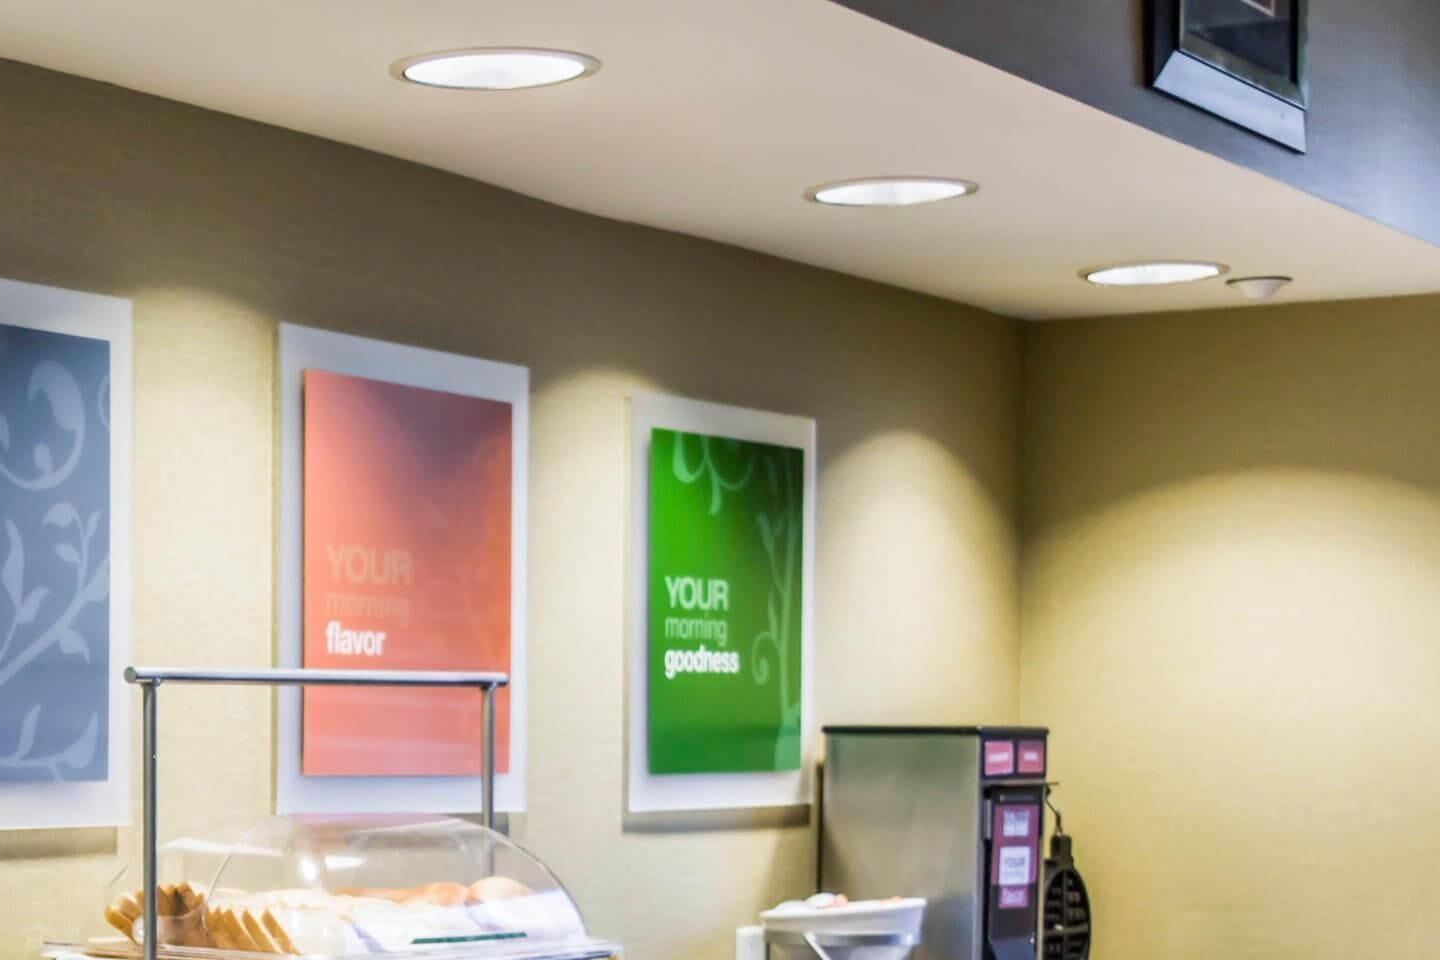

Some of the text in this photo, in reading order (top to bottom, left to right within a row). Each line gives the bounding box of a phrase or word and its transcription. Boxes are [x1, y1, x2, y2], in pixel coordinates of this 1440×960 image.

[326, 545, 413, 586] YOUR
[664, 576, 729, 611] YOUR
[326, 621, 386, 656] flavor
[665, 612, 727, 647] morning
[664, 644, 740, 679] goodness
